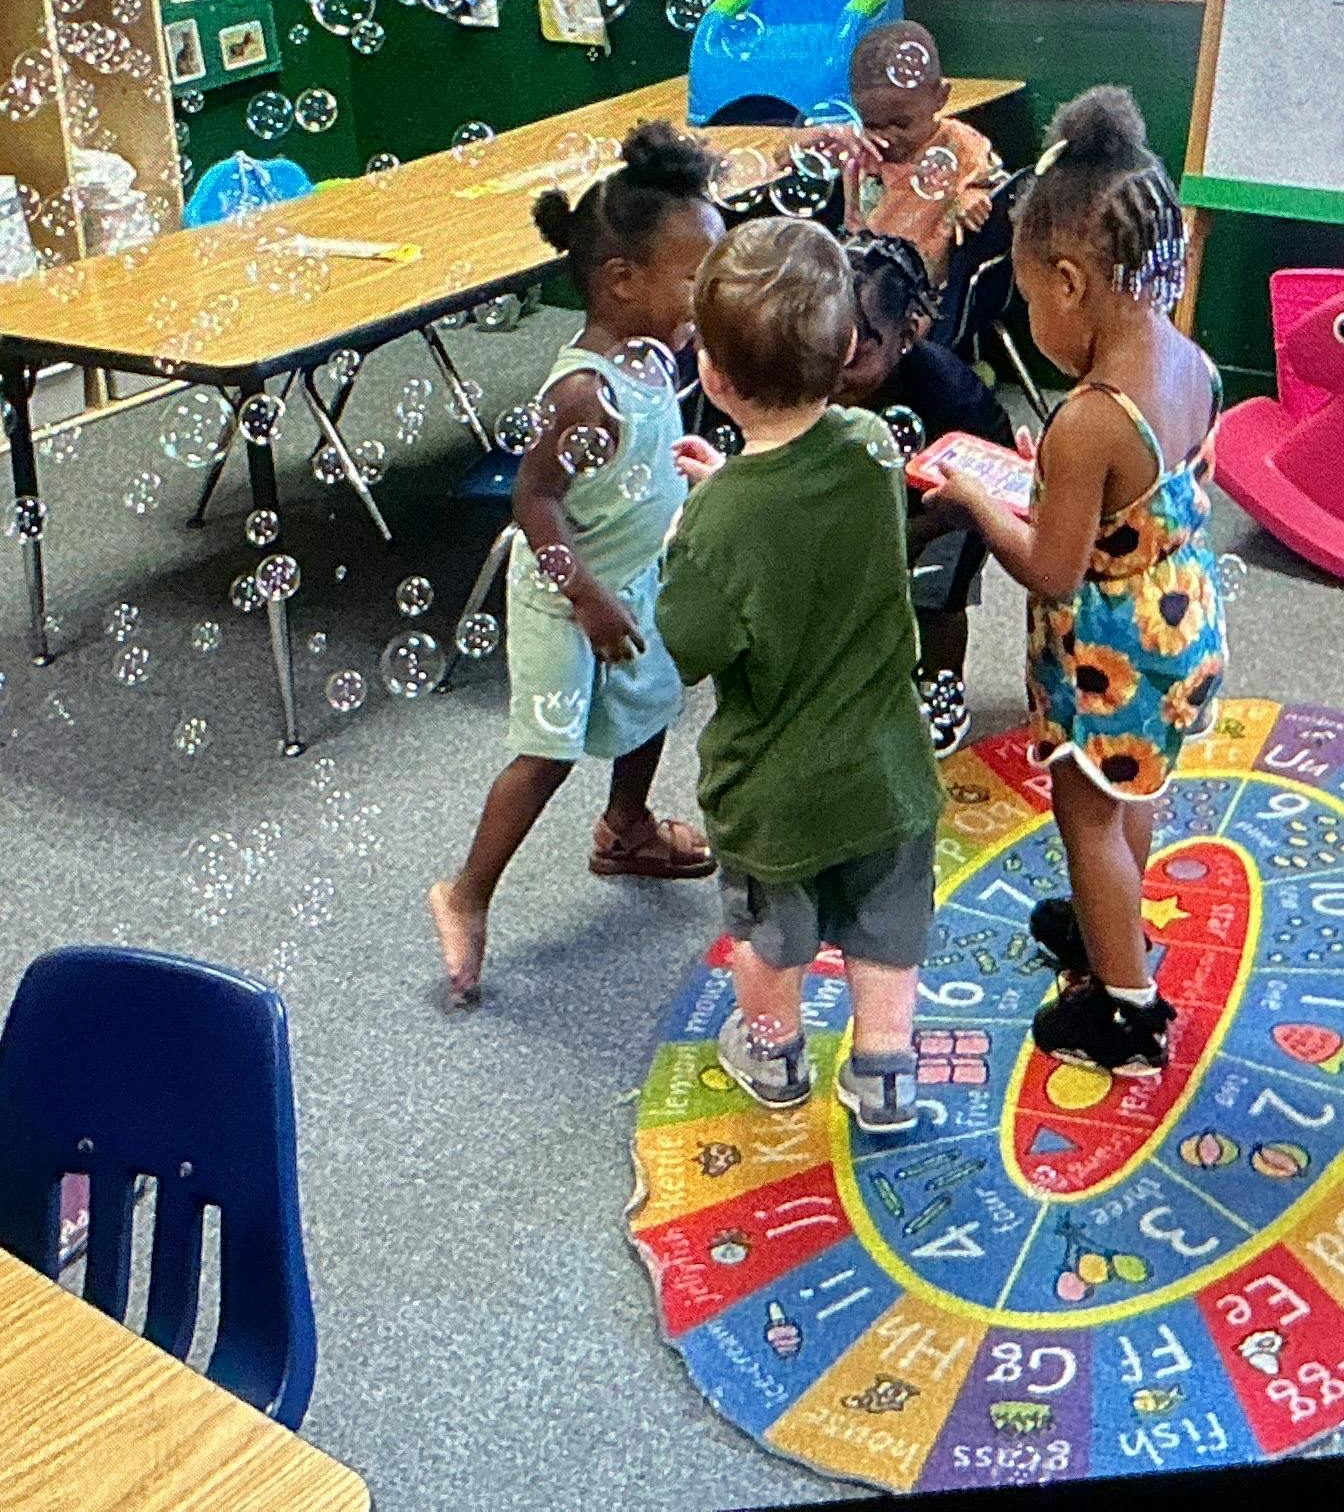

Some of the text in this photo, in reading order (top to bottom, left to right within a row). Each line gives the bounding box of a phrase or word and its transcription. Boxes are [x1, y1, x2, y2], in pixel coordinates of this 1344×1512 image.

[1264, 743, 1330, 778] Uu
[1256, 792, 1311, 819] 9
[916, 980, 986, 1006] 6
[1248, 1087, 1336, 1129] 2
[752, 1110, 810, 1164] Kk
[975, 1186, 1026, 1235] four
[1090, 1176, 1164, 1225] three
[910, 1220, 987, 1258] 4
[1139, 1205, 1220, 1257] 3
[1215, 1273, 1312, 1327] Ee
[875, 1315, 969, 1381] Hh
[986, 1340, 1078, 1394] Gg
[1120, 1323, 1193, 1384] Ff
[953, 1438, 1074, 1473] grass
[1119, 1411, 1229, 1467] fish
